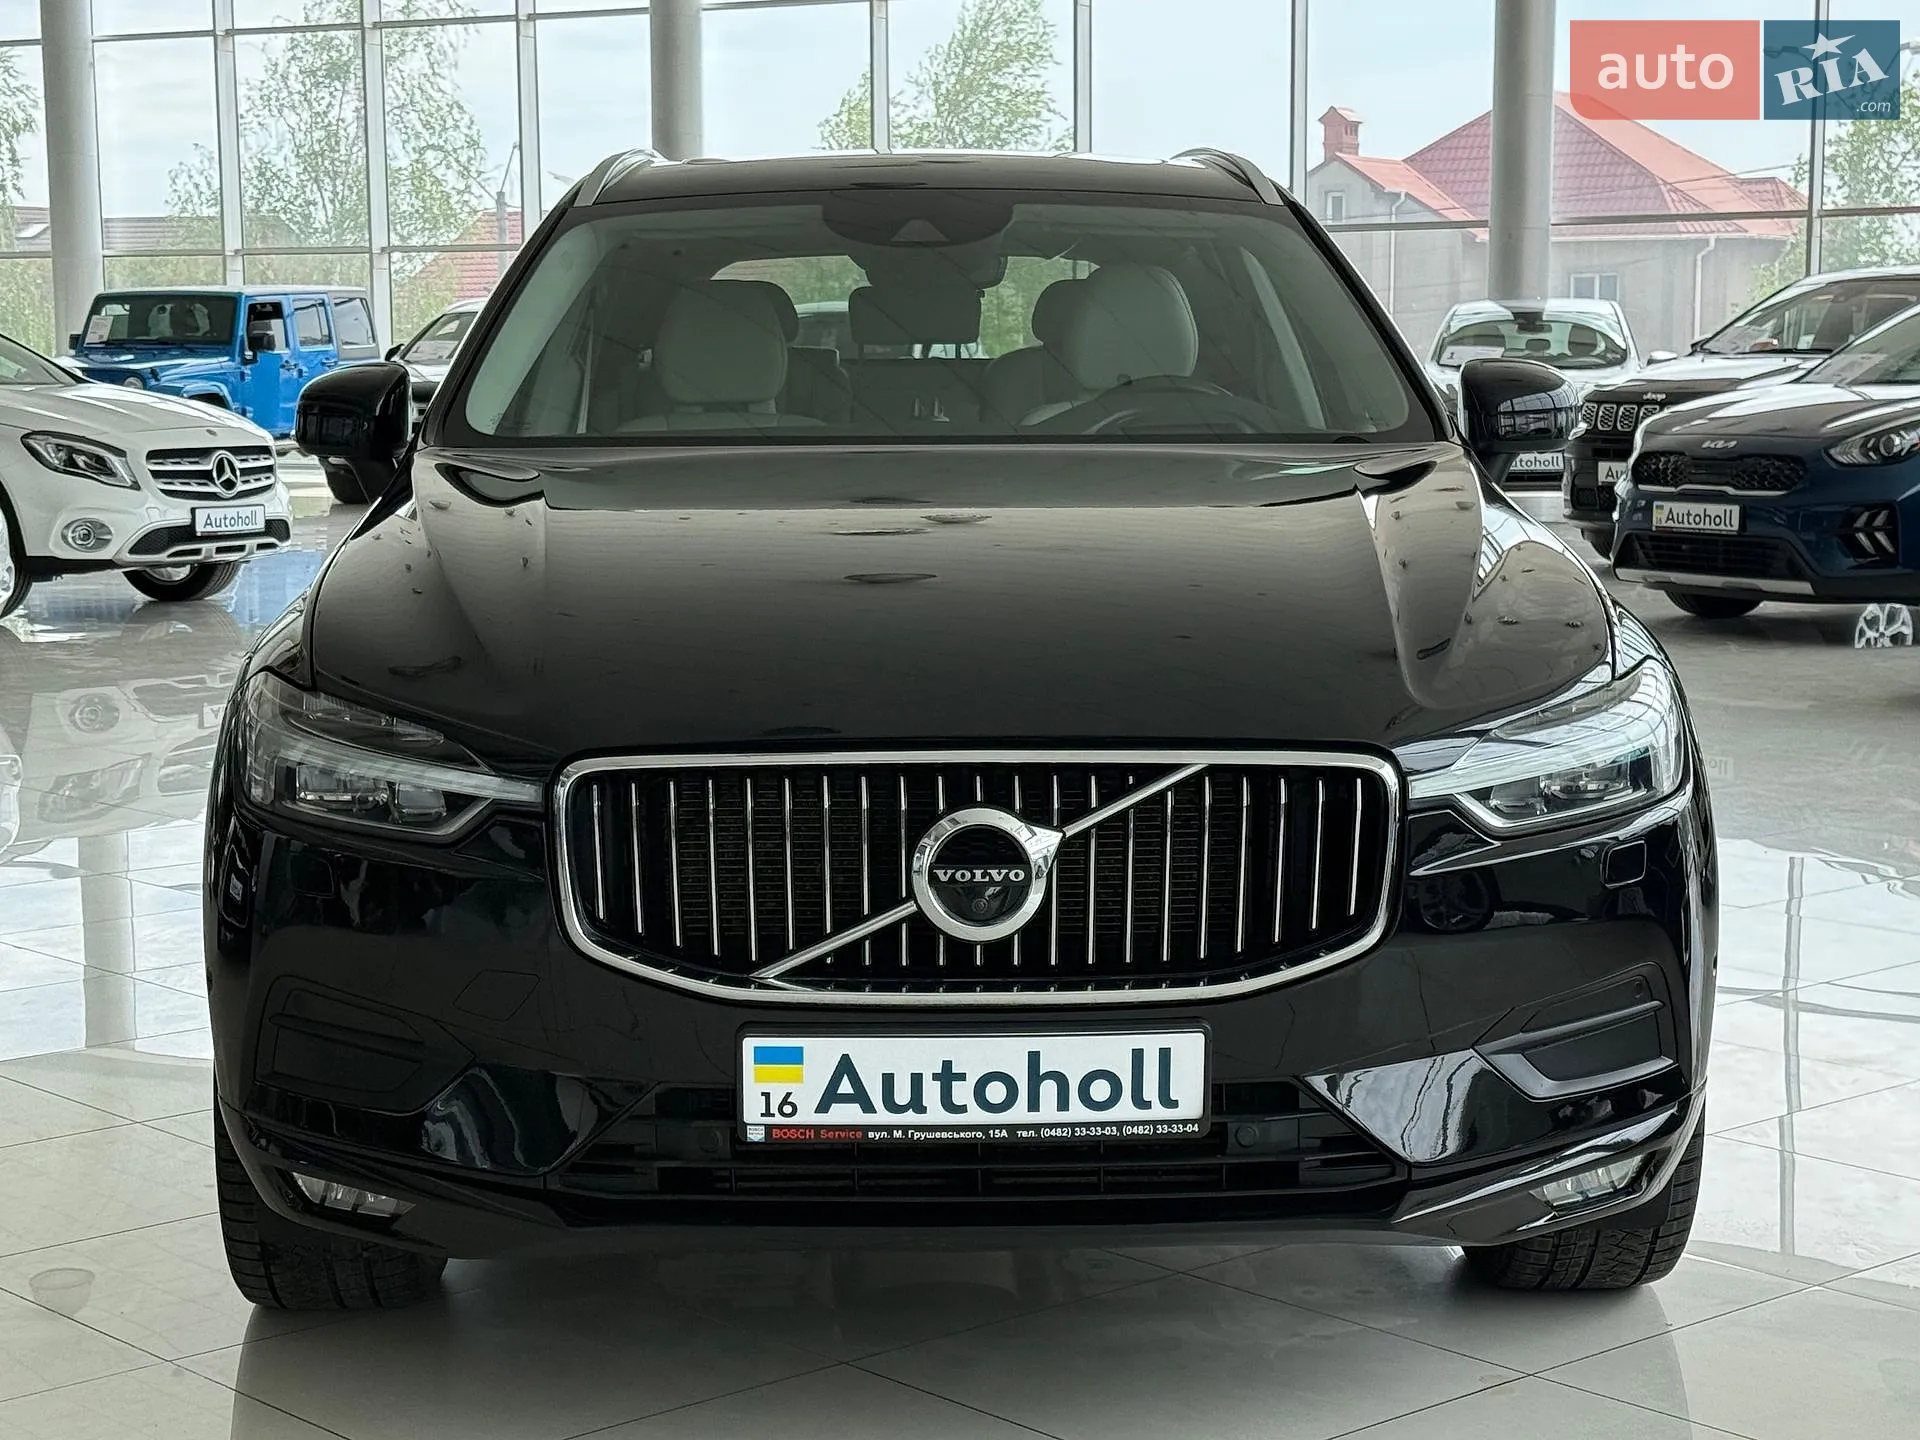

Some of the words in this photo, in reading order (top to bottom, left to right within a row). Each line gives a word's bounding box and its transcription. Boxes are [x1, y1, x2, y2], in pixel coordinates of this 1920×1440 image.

[203, 510, 257, 528] Autoholl
[1665, 507, 1734, 528] Autoholl
[933, 870, 1025, 882] VOLVO
[814, 1047, 1179, 1115] Autoholl
[759, 1091, 798, 1118] 16
[772, 1129, 815, 1139] BOSCH
[819, 1130, 863, 1139] Service
[868, 1131, 891, 1139] вул.
[894, 1130, 906, 1139] М.
[909, 1130, 987, 1140] Грушевського,
[1016, 1130, 1038, 1138] тел.
[1041, 1128, 1072, 1139] (0482)
[1075, 1127, 1120, 1138] 33-33-03,
[1123, 1126, 1154, 1137] (0482)
[1157, 1124, 1199, 1134] 33-33-04
